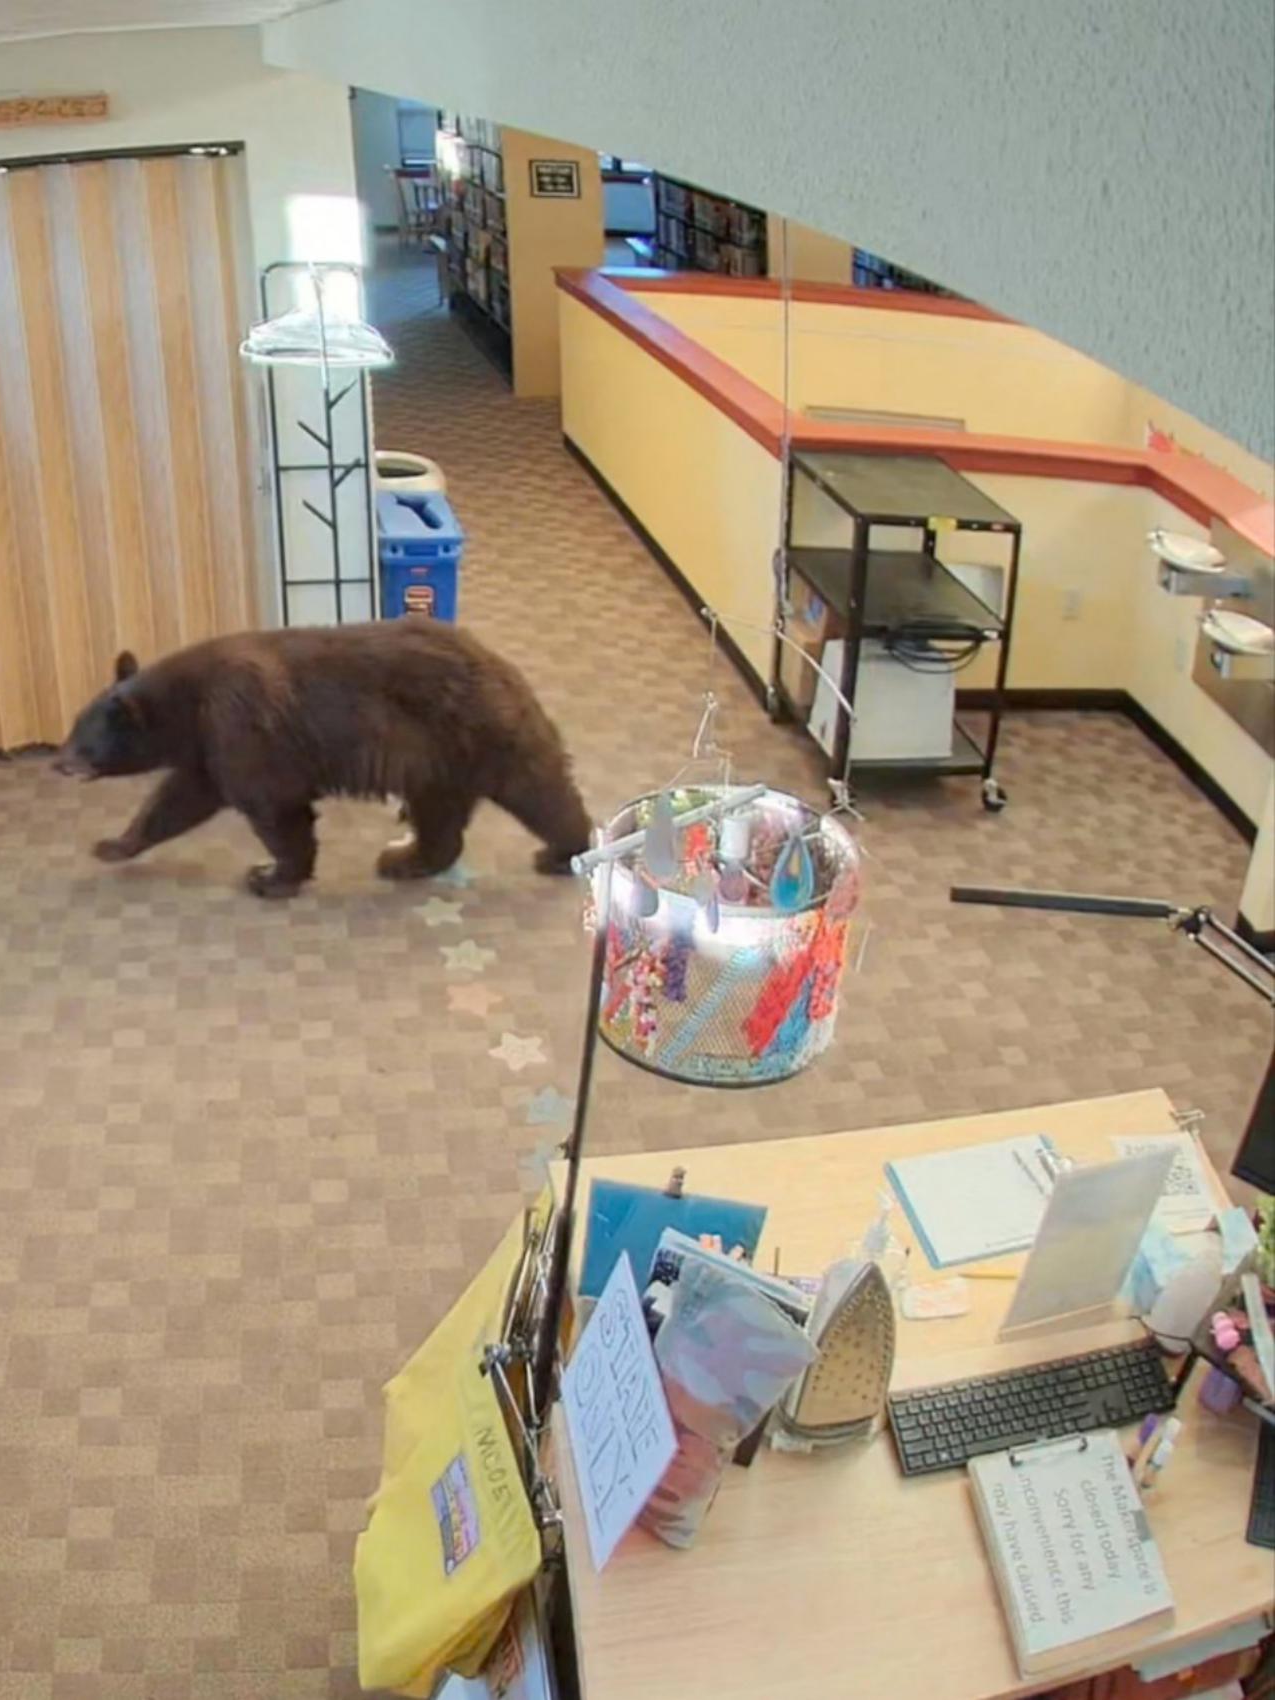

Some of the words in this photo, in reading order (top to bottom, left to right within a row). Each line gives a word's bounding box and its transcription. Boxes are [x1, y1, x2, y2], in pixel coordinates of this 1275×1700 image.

[599, 1288, 659, 1464] STAFF
[575, 1344, 634, 1536] ONLY
[1053, 1487, 1075, 1532] Sorry
[1080, 1479, 1108, 1530] closed
[1101, 1455, 1117, 1482] The
[1111, 1483, 1150, 1581] Makerspace
[1143, 1581, 1158, 1596] is
[992, 1482, 1011, 1517] may
[1003, 1518, 1023, 1562] have
[1015, 1564, 1045, 1624] caused
[1070, 1532, 1087, 1556] for
[1078, 1560, 1095, 1592] any
[1056, 1591, 1074, 1625] this
